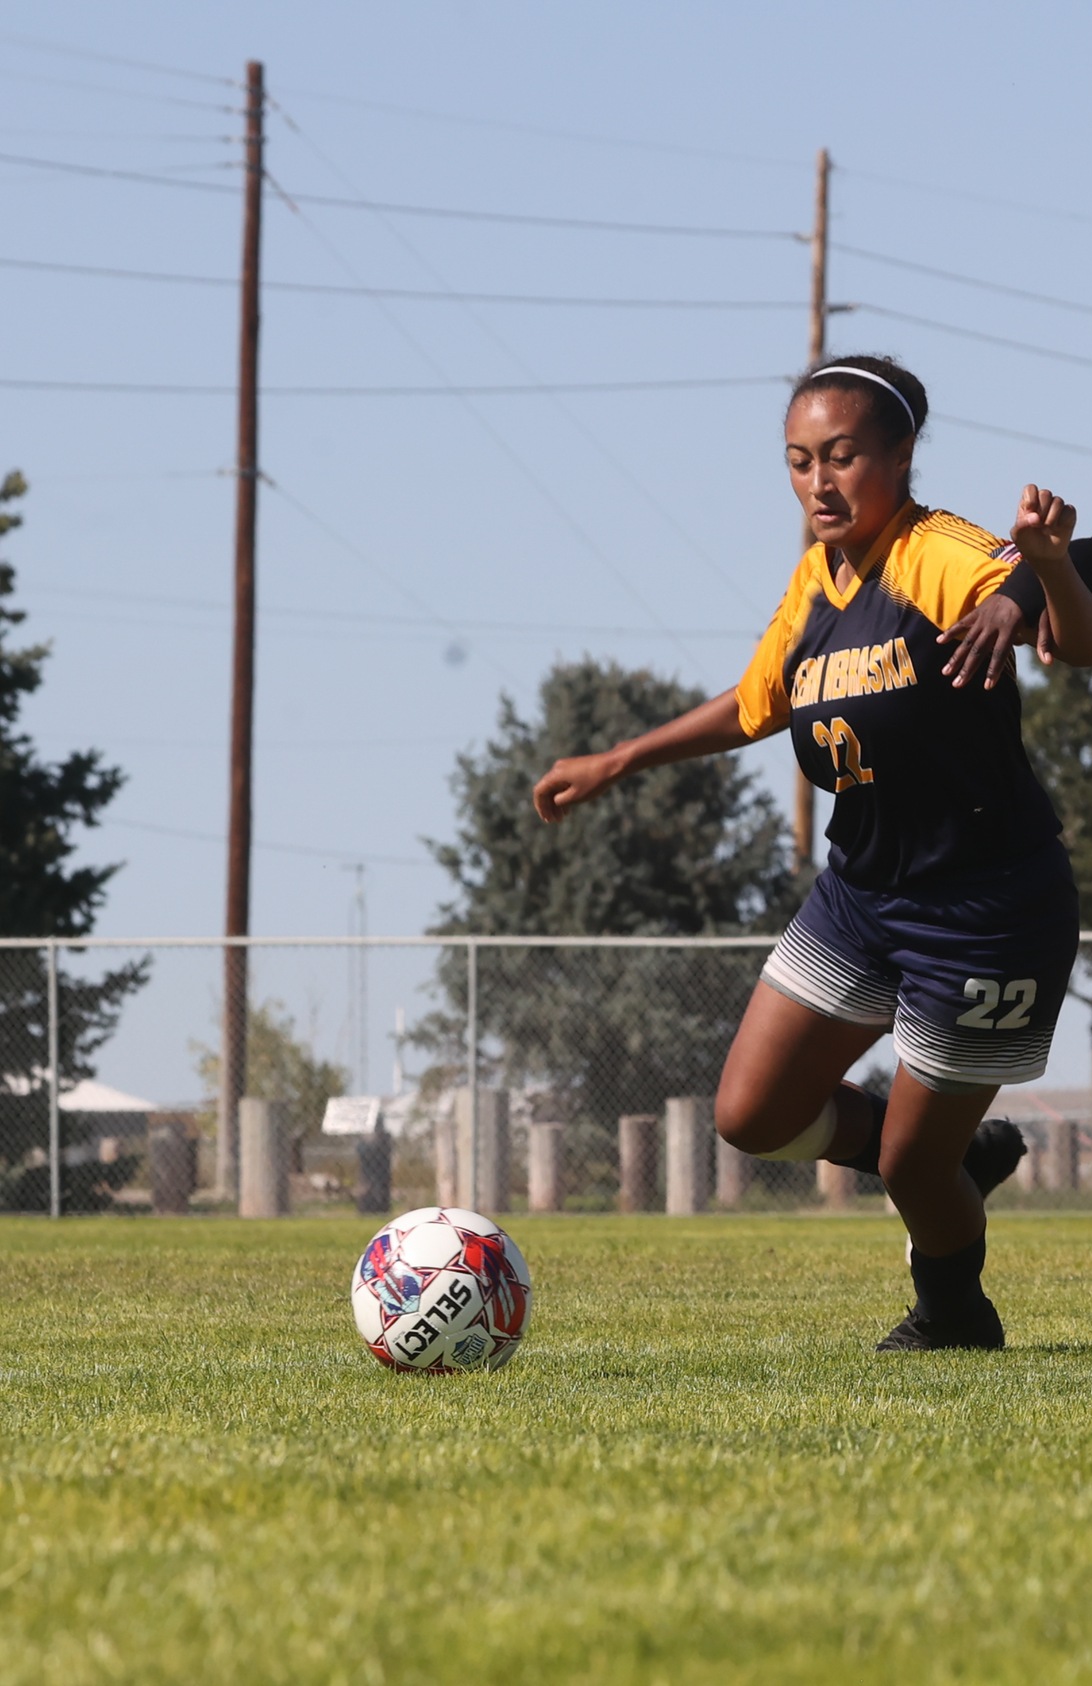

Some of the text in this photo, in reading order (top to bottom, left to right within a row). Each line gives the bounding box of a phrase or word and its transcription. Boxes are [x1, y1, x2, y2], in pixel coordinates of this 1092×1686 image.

[812, 717, 874, 793] 22
[956, 978, 1037, 1029] 22
[395, 1279, 472, 1361] SELECT
